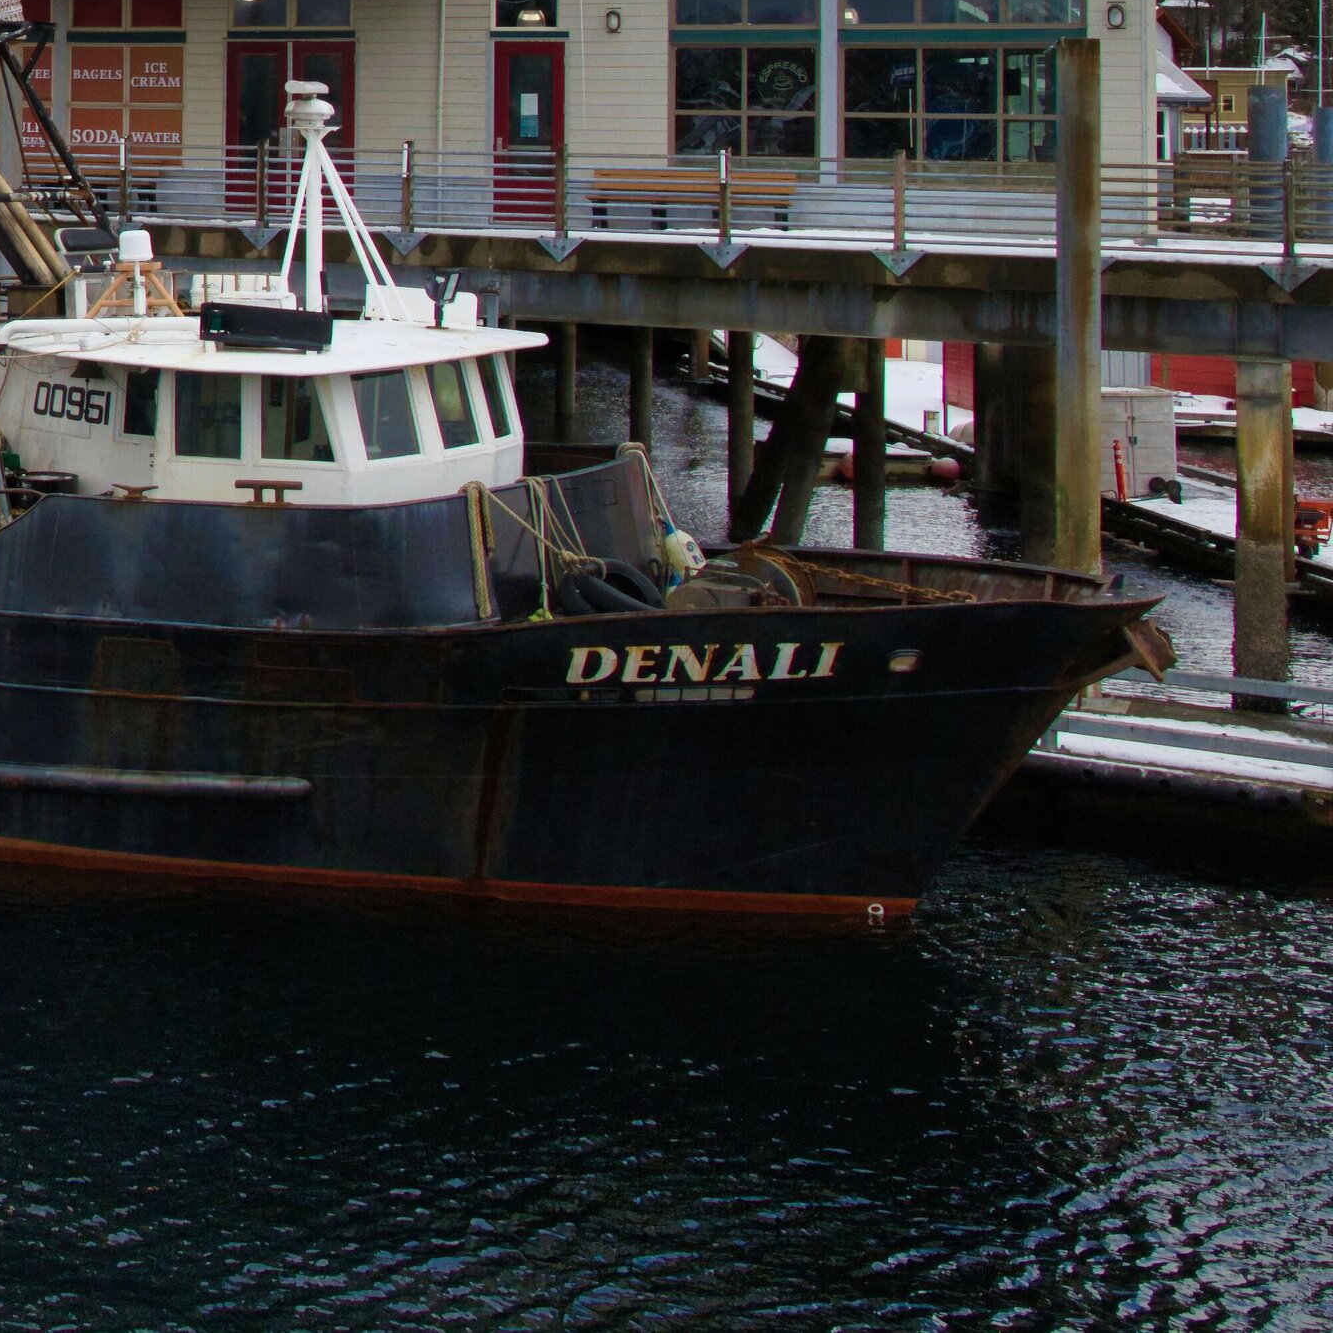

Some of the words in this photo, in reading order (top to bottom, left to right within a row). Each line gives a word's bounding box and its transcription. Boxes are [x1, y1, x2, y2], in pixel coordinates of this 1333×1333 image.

[145, 62, 167, 73] ICE
[759, 61, 807, 83] ESPRESSO
[73, 69, 122, 80] BAGELS
[131, 76, 180, 88] CREAM
[72, 129, 121, 144] SODA
[131, 131, 181, 143] WATER
[565, 642, 845, 684] DENALI
